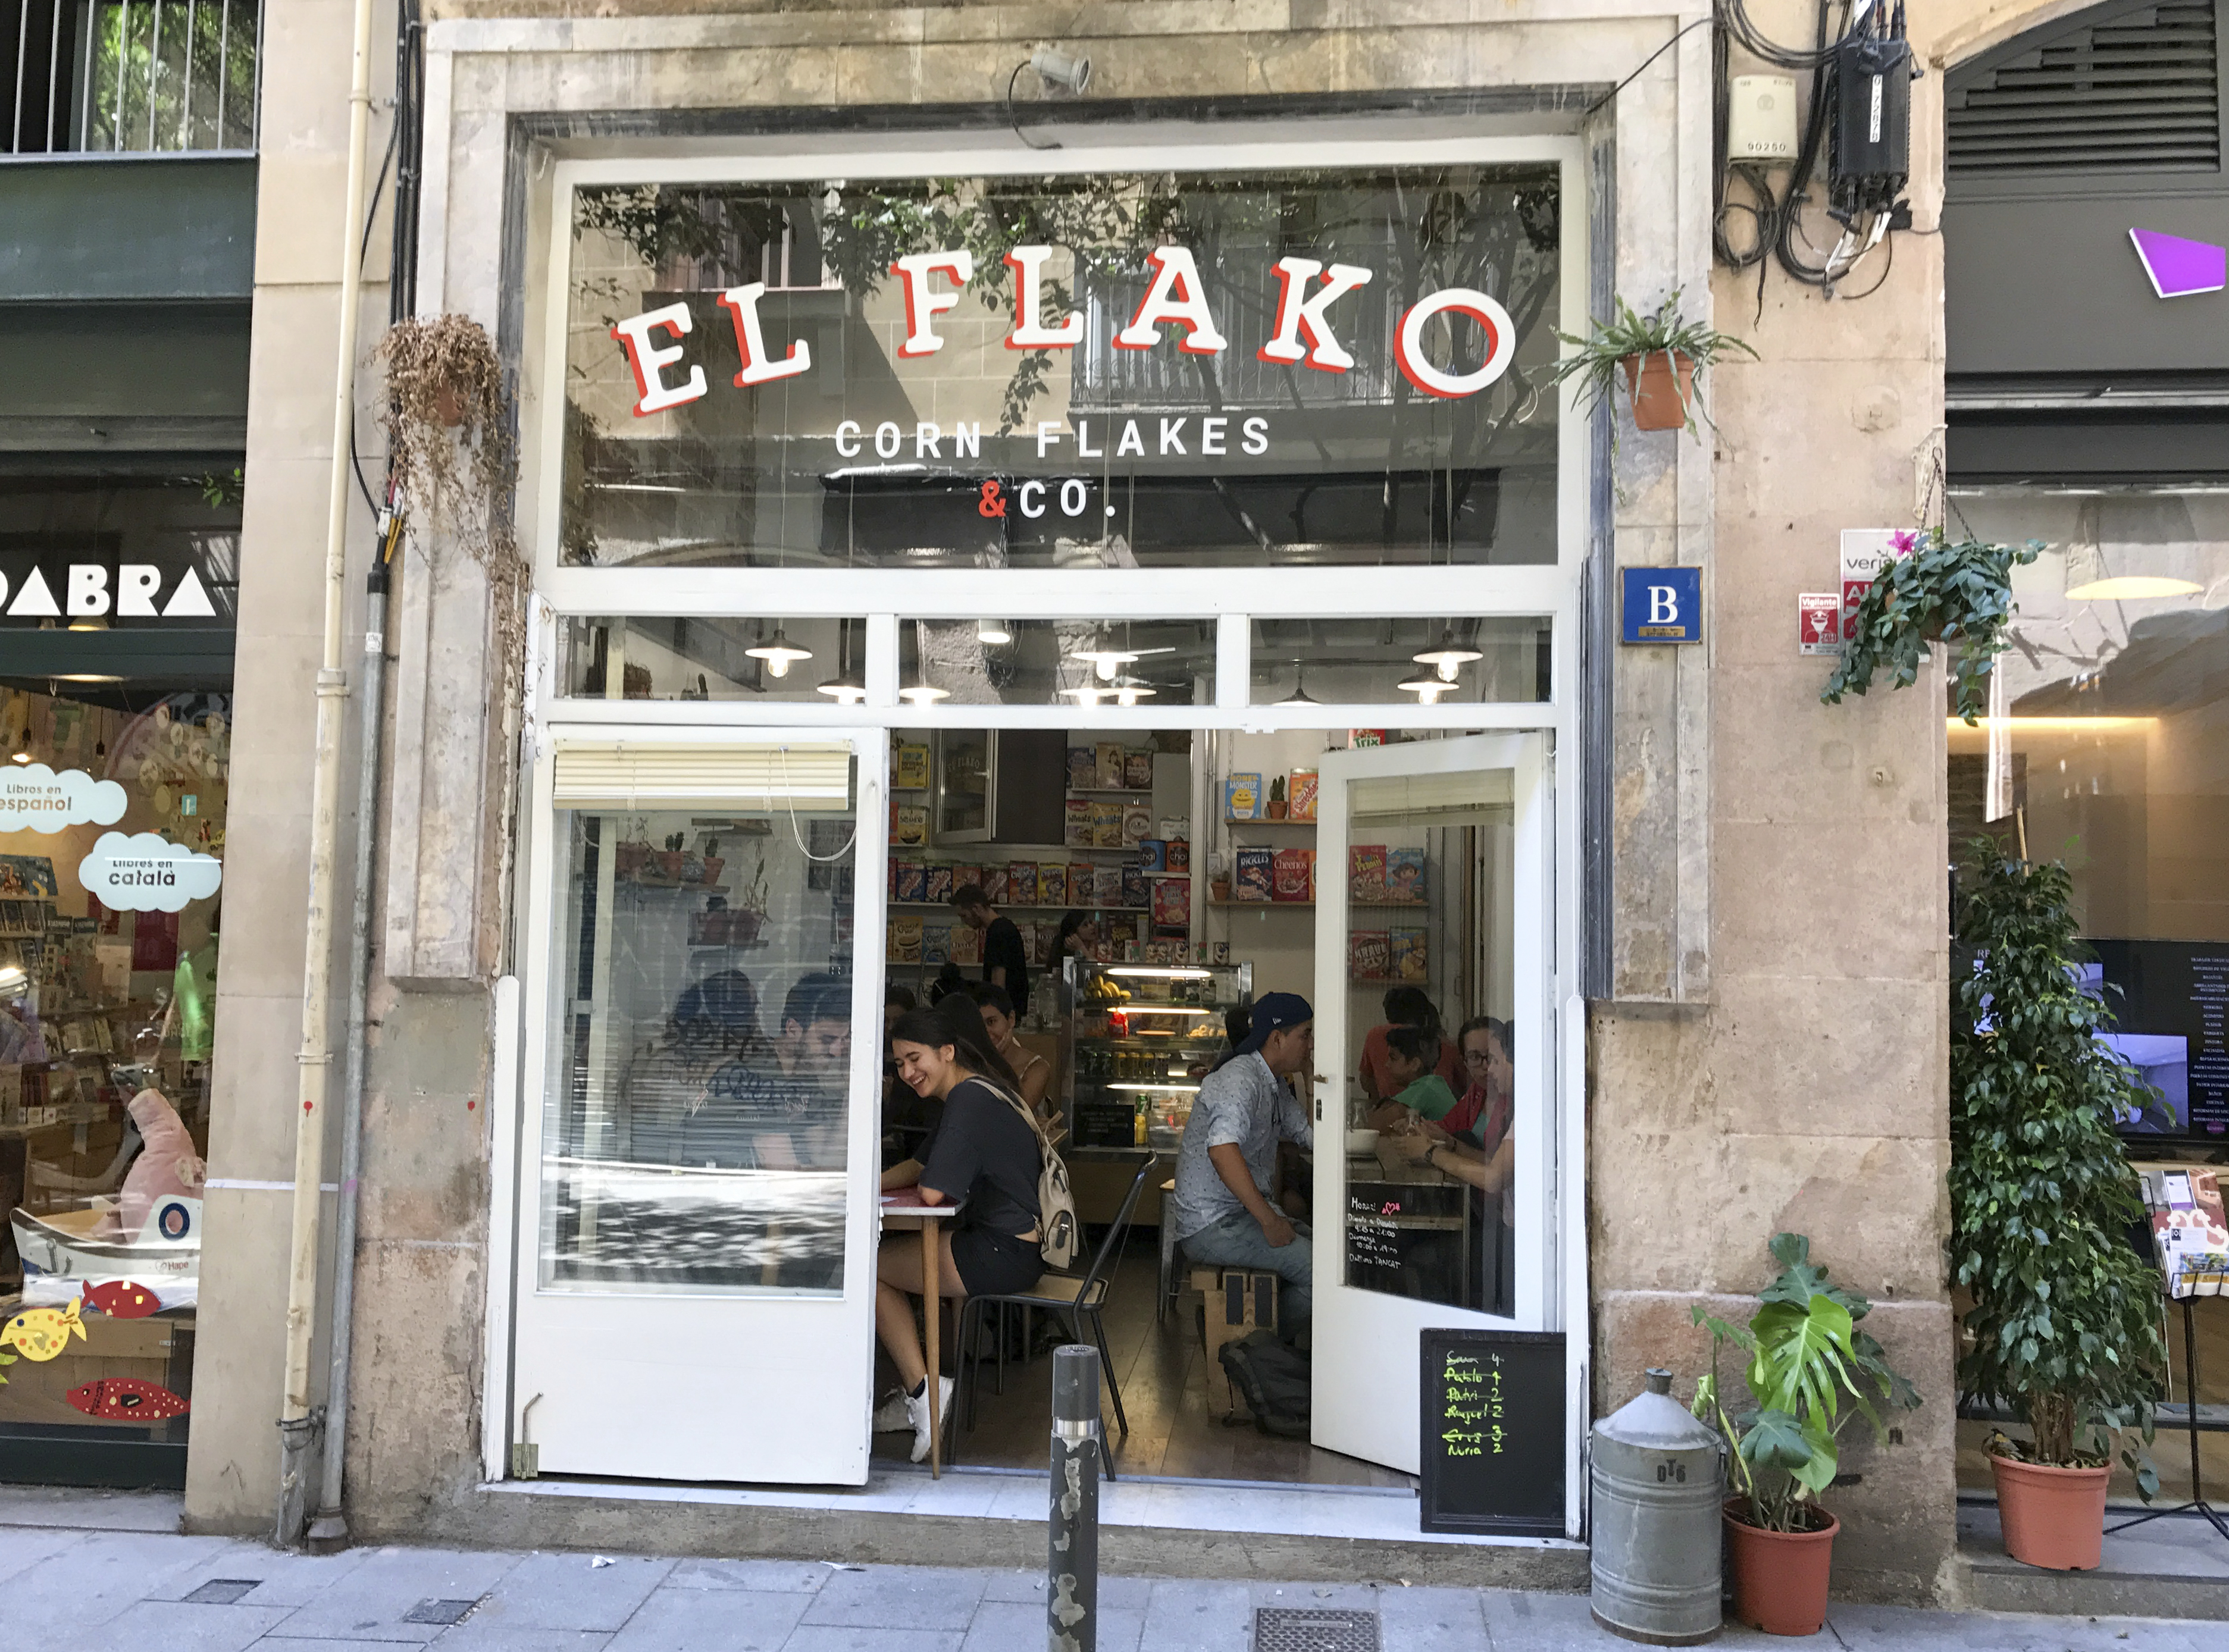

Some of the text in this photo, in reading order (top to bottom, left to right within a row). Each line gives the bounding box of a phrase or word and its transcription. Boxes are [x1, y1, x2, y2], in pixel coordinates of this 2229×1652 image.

[1747, 142, 1786, 152] 90250
[612, 245, 1516, 416] EL FLAKO
[836, 417, 1269, 459] CORN FLAKES
[0, 565, 217, 616] ABRA
[1648, 586, 1678, 623] B
[1802, 598, 1837, 607] Vigilante
[1353, 734, 1379, 748] Trix
[7, 783, 42, 794] Libros
[1229, 781, 1257, 789] MONSTER
[0, 796, 71, 813] español
[1274, 860, 1307, 870] Cheerios
[109, 870, 175, 886] català
[168, 1261, 189, 1271] Hape
[1444, 1366, 1482, 1384] Pablo
[1493, 1444, 1503, 1454] 2
